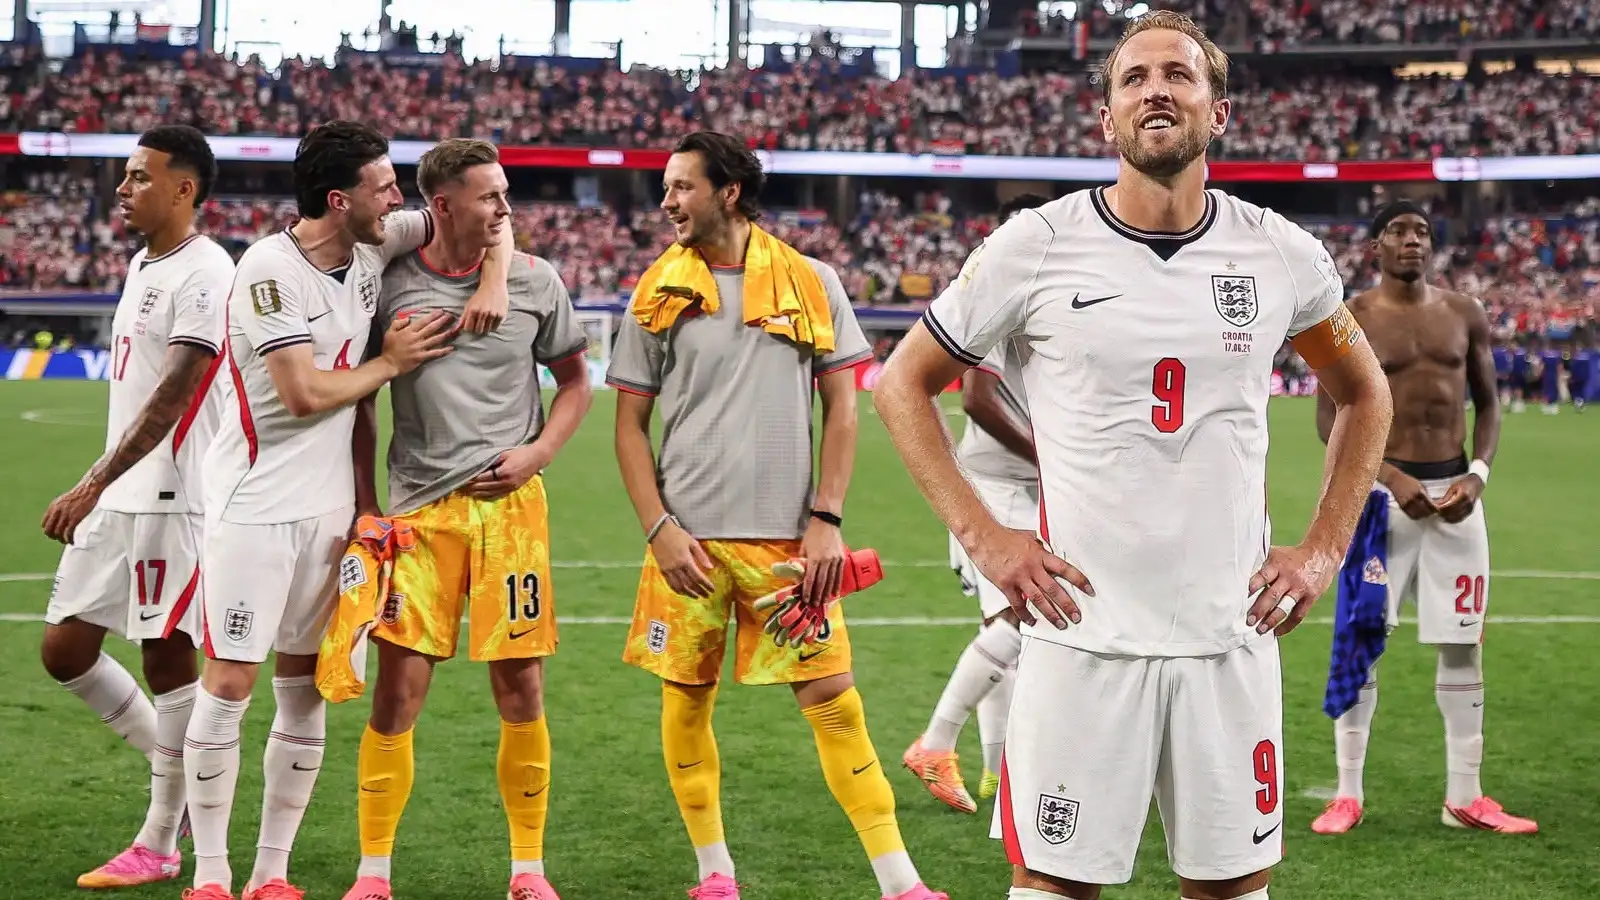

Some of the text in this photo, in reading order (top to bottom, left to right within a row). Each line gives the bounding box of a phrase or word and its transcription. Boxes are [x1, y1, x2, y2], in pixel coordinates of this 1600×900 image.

[113, 334, 131, 381] 17
[333, 338, 352, 370] 4
[1222, 331, 1253, 342] CROATIA
[1151, 357, 1186, 433] 9
[135, 559, 166, 606] 17
[505, 572, 541, 621] 13
[1455, 575, 1484, 614] 20
[1252, 739, 1279, 815] 9
